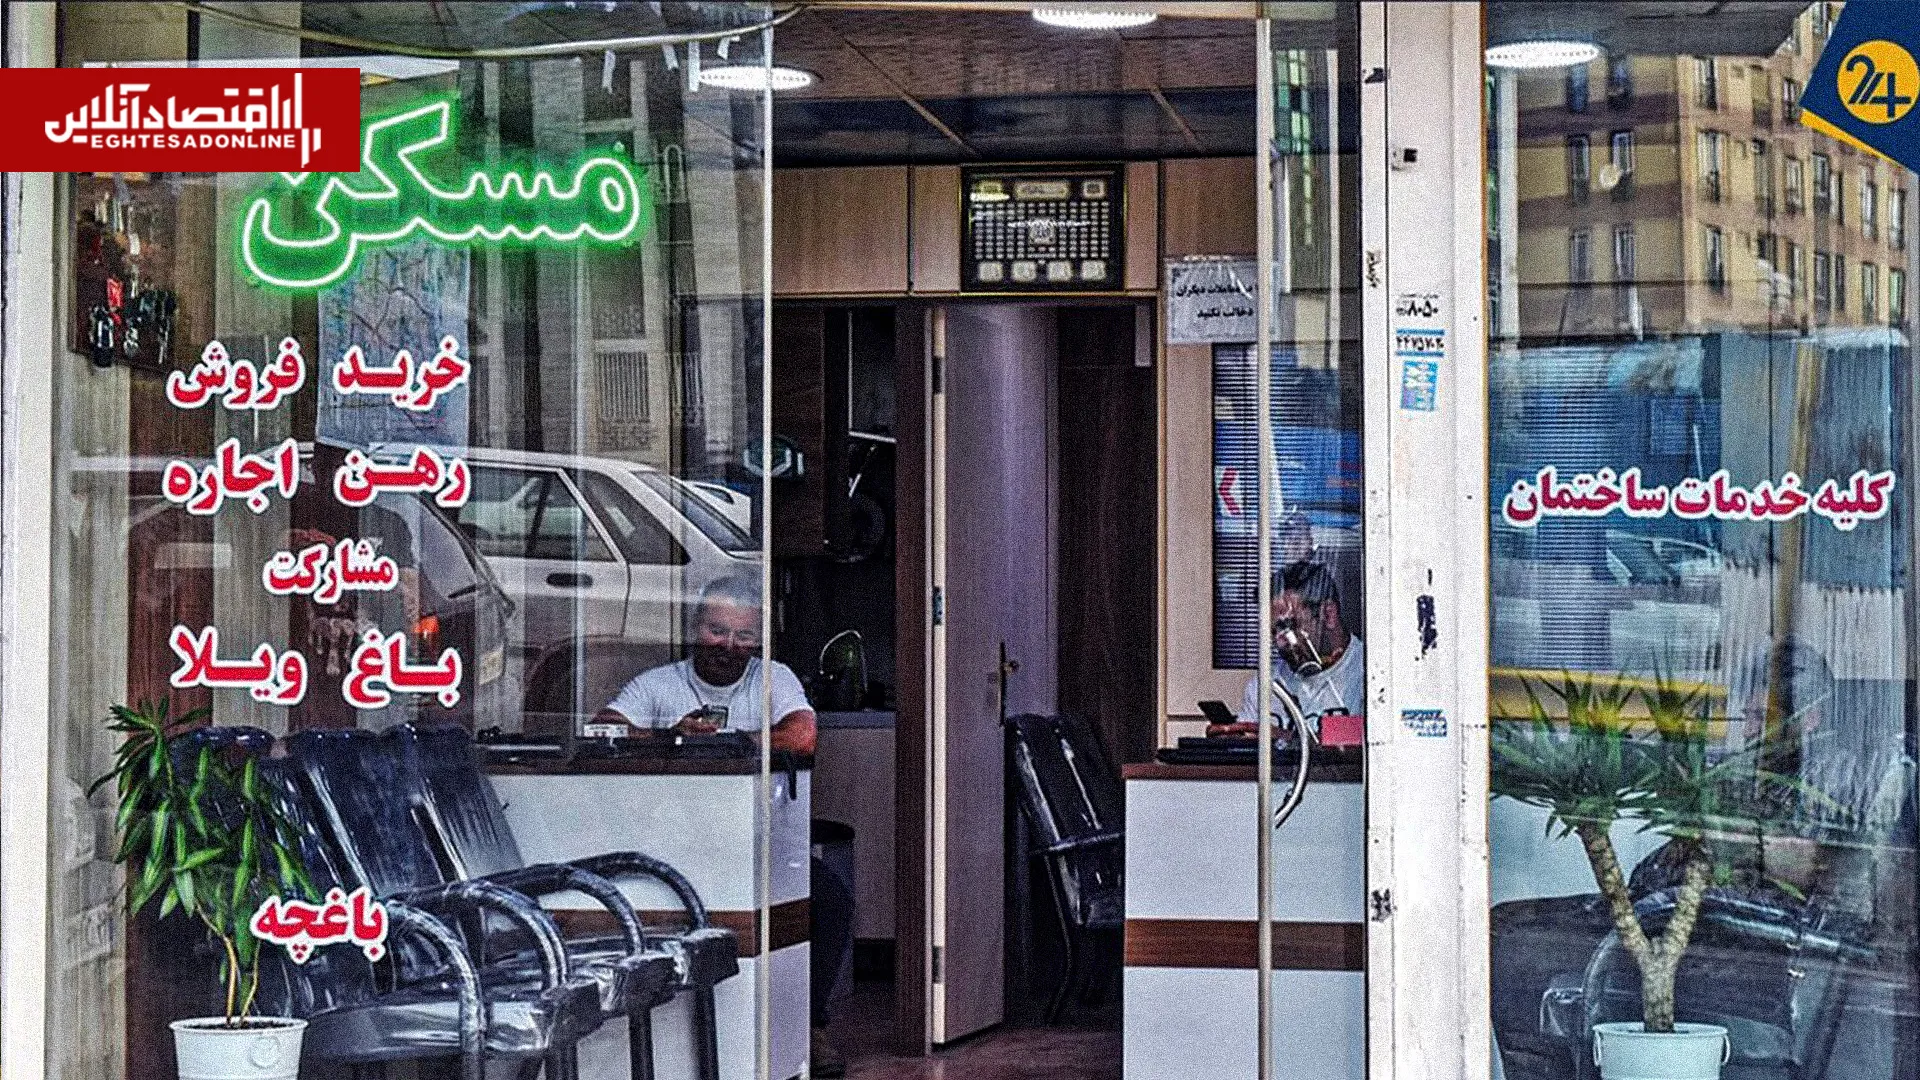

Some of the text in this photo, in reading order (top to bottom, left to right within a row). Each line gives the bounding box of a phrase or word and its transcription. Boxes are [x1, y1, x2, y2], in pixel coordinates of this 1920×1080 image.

[242, 101, 642, 287] مسکن
[170, 338, 468, 409] خرید فروش
[165, 442, 468, 512] رهن اجاره
[1504, 470, 1894, 535] کلیه خدمات ساختمان
[265, 540, 396, 602] مشارکت
[172, 628, 461, 706] باغ ویلا
[253, 888, 387, 962] باغچه
